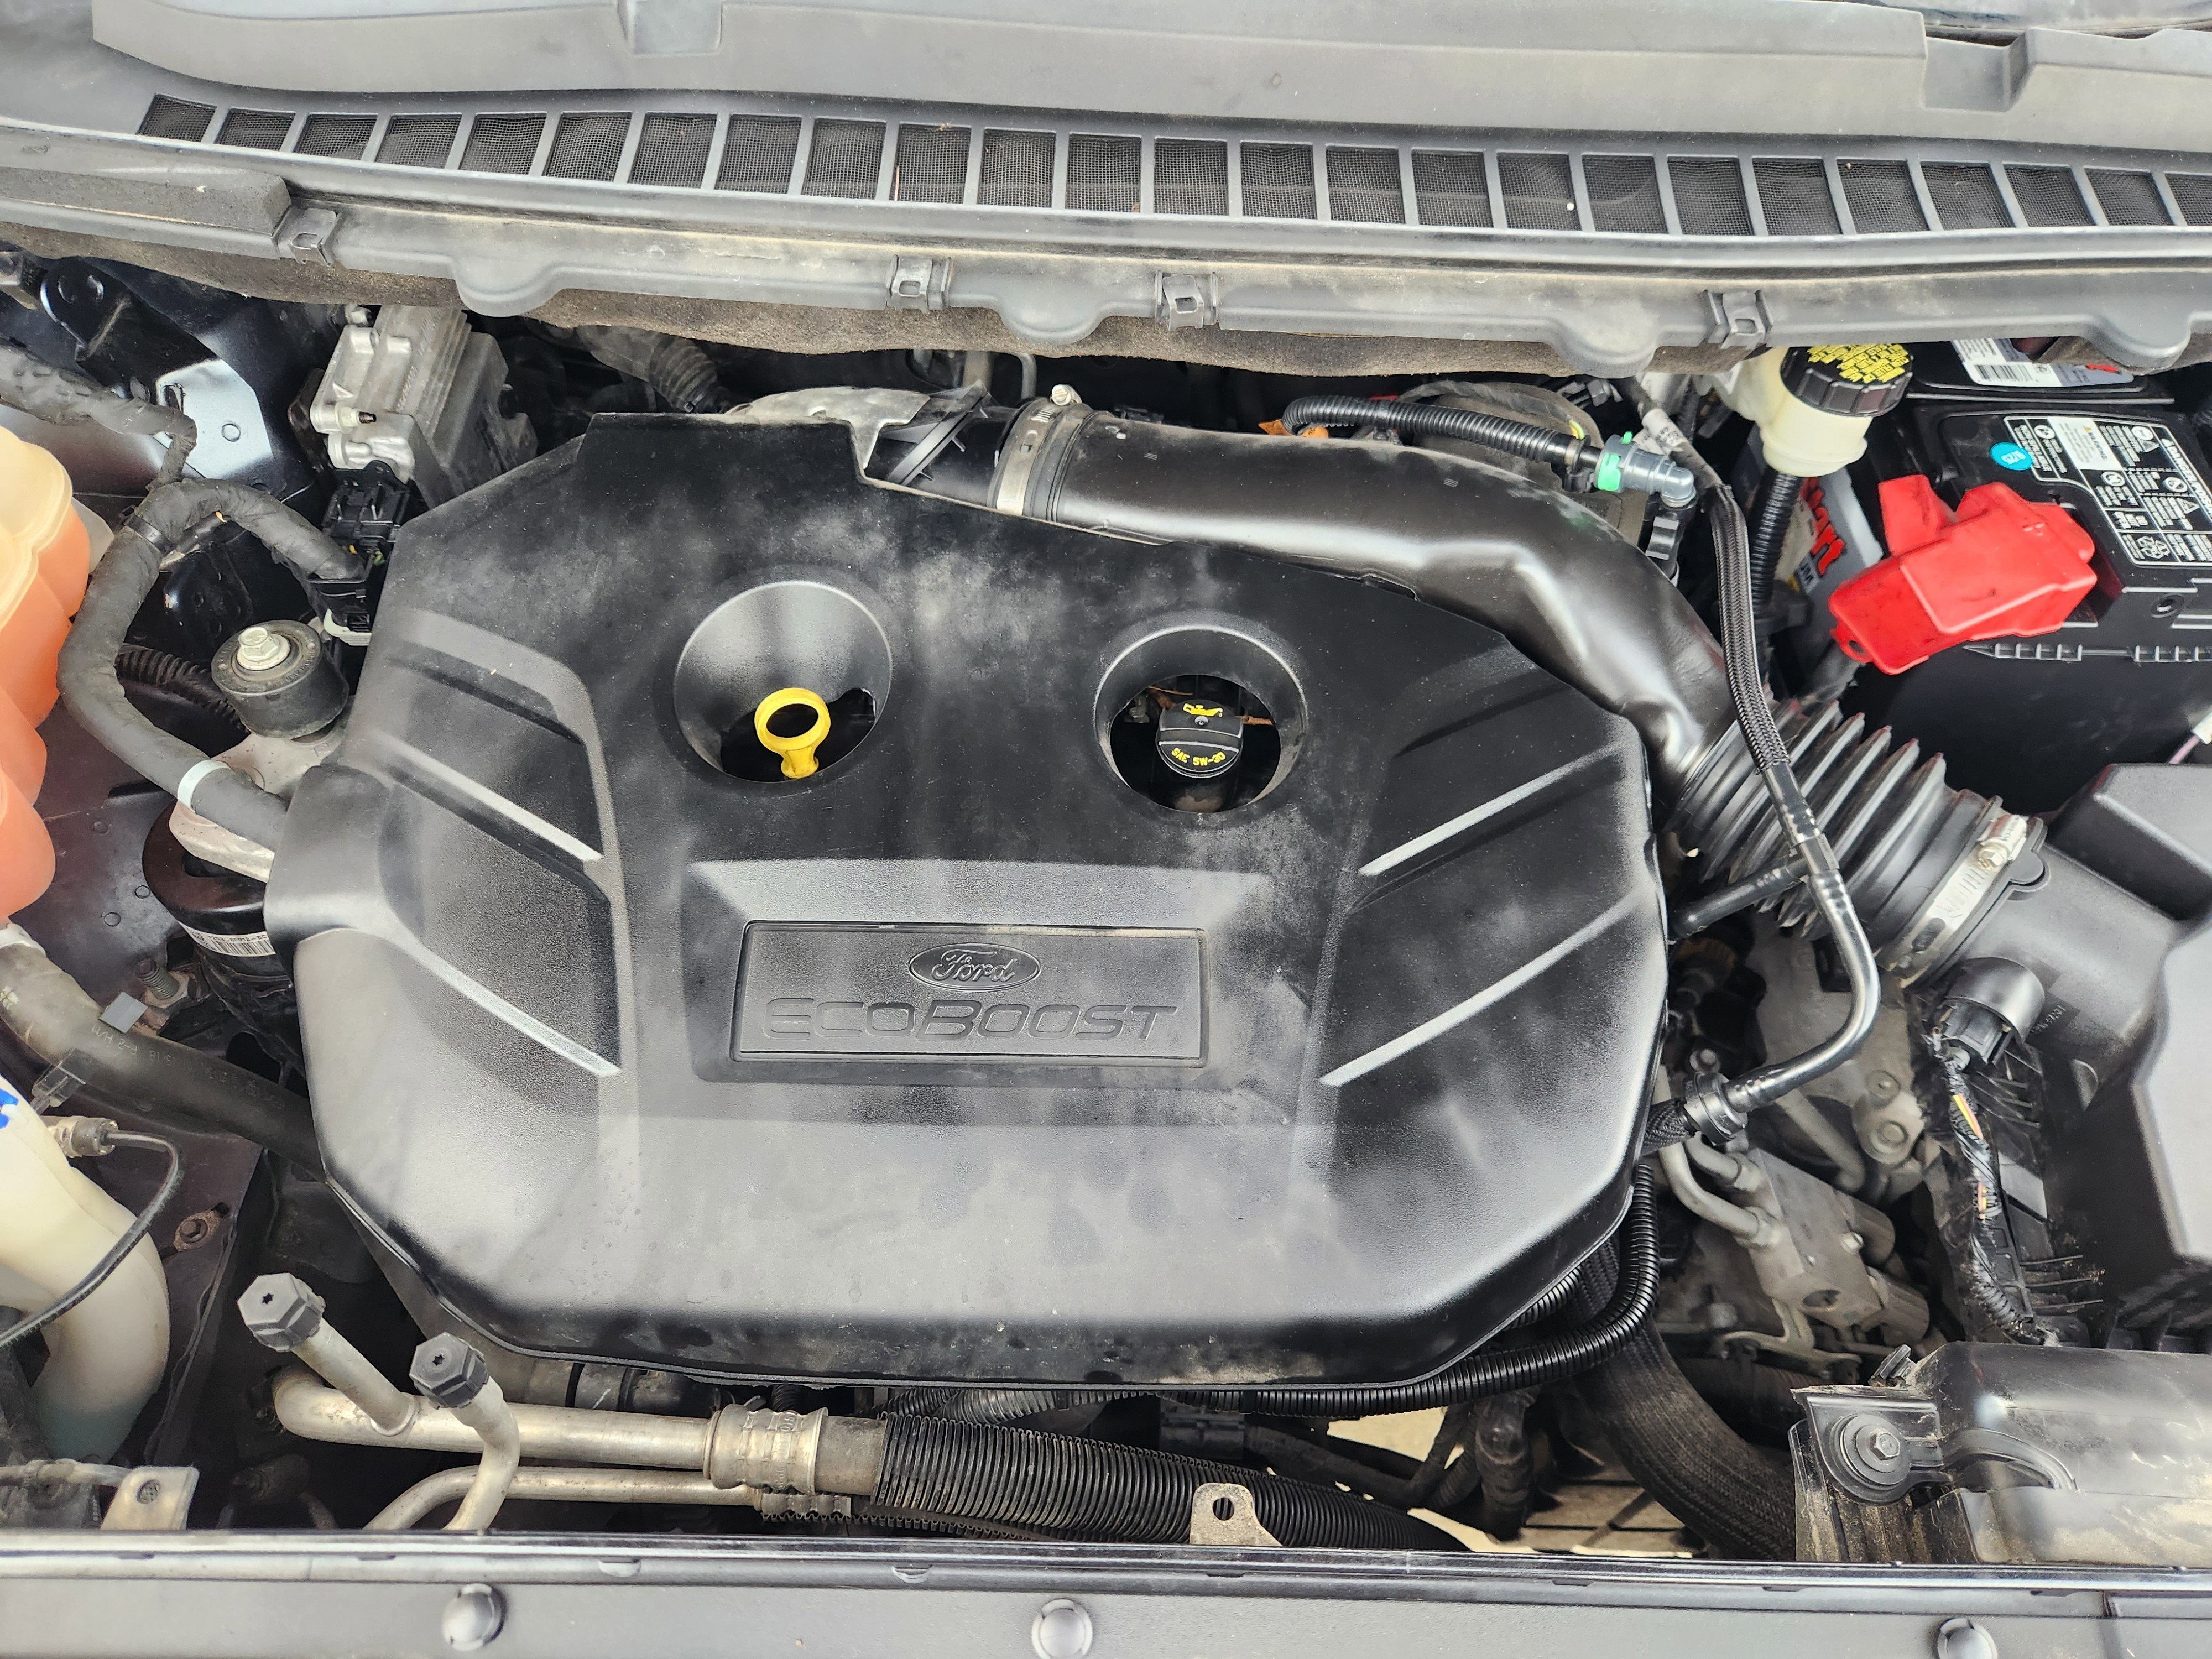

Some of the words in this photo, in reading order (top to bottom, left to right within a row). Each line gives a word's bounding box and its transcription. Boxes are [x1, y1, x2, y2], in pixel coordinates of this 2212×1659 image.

[1171, 747, 1190, 763] SAE
[1192, 752, 1226, 766] 5W-30
[931, 948, 1016, 982] Ford
